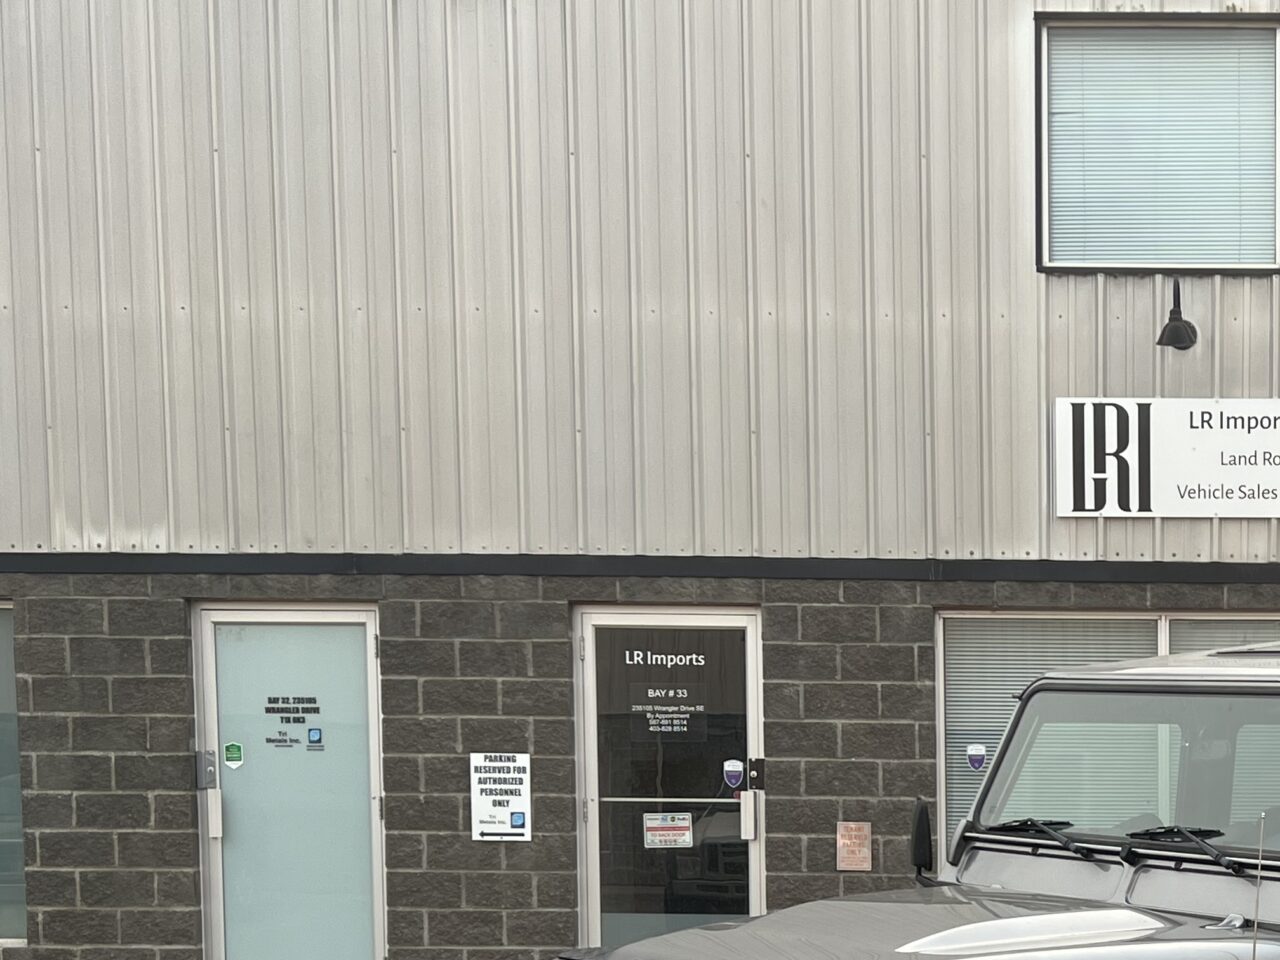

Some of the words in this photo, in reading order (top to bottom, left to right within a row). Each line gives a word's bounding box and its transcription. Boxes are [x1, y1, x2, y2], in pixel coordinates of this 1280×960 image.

[1188, 410, 1214, 430] LR
[1220, 450, 1258, 467] Land
[1176, 483, 1235, 500] Vehicle
[1238, 484, 1278, 500] Sales
[625, 650, 644, 665] LR
[646, 650, 706, 669] Imports
[647, 688, 667, 698] BAY
[668, 688, 675, 697] #
[676, 688, 688, 698] 33
[653, 705, 679, 713] Wrangler
[483, 754, 517, 763] PARKING
[473, 765, 512, 774] RESERVED
[512, 766, 527, 774] FOR
[477, 776, 524, 785] AUTHORIZED
[480, 788, 522, 797] PERSONNEL
[491, 799, 510, 808] ONLY
